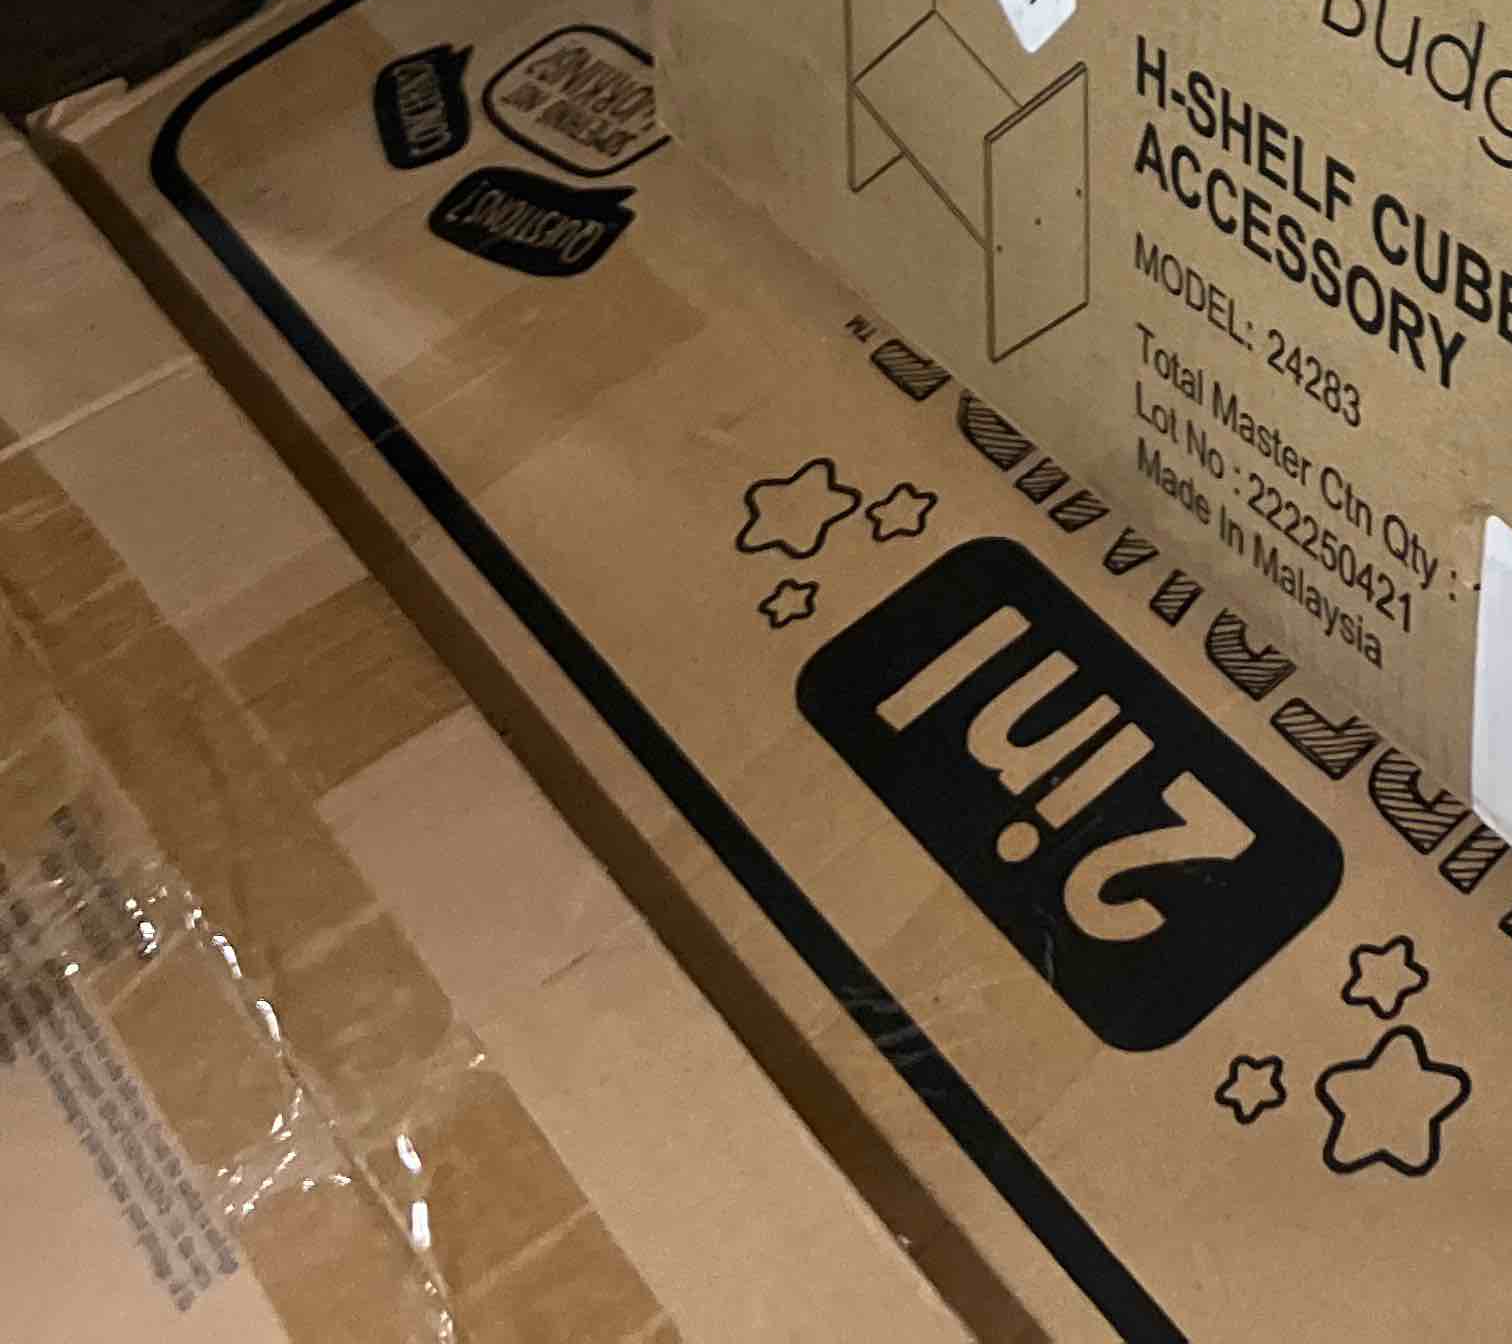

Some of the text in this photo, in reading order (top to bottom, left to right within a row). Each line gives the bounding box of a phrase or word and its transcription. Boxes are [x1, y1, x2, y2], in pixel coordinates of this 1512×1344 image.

[1135, 34, 1357, 224] H-SHELF
[1134, 121, 1468, 390] ACCESSORY
[1134, 232, 1364, 428] MODEL: 24283
[1135, 322, 1203, 390] Total
[1212, 372, 1314, 486] Master
[1321, 467, 1374, 540] Ctn
[1384, 516, 1440, 592] Qty
[1135, 382, 1181, 437] Lot
[1187, 428, 1226, 482] No
[1248, 472, 1414, 634] 222250421
[1136, 438, 1211, 526] Made
[1251, 535, 1385, 670] Malaysia
